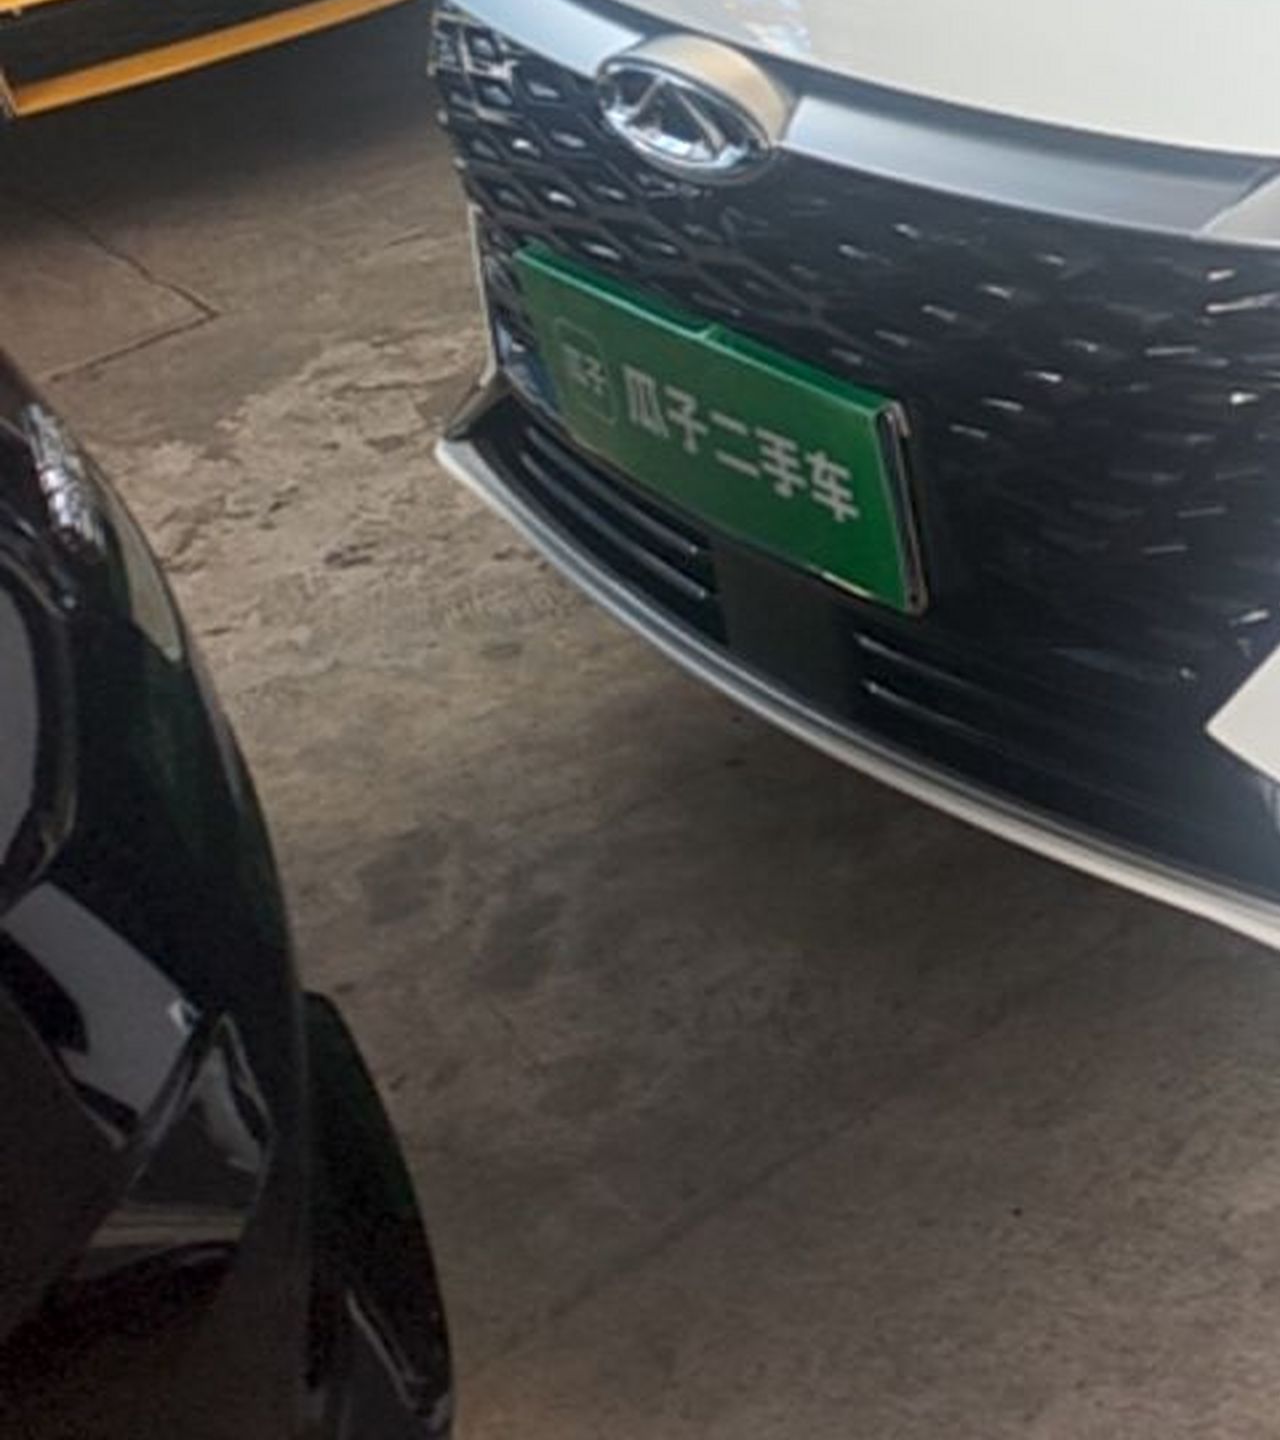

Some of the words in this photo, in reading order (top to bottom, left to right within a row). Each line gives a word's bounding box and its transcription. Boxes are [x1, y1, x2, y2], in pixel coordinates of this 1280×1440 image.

[619, 363, 861, 524] 瓜子二手车
